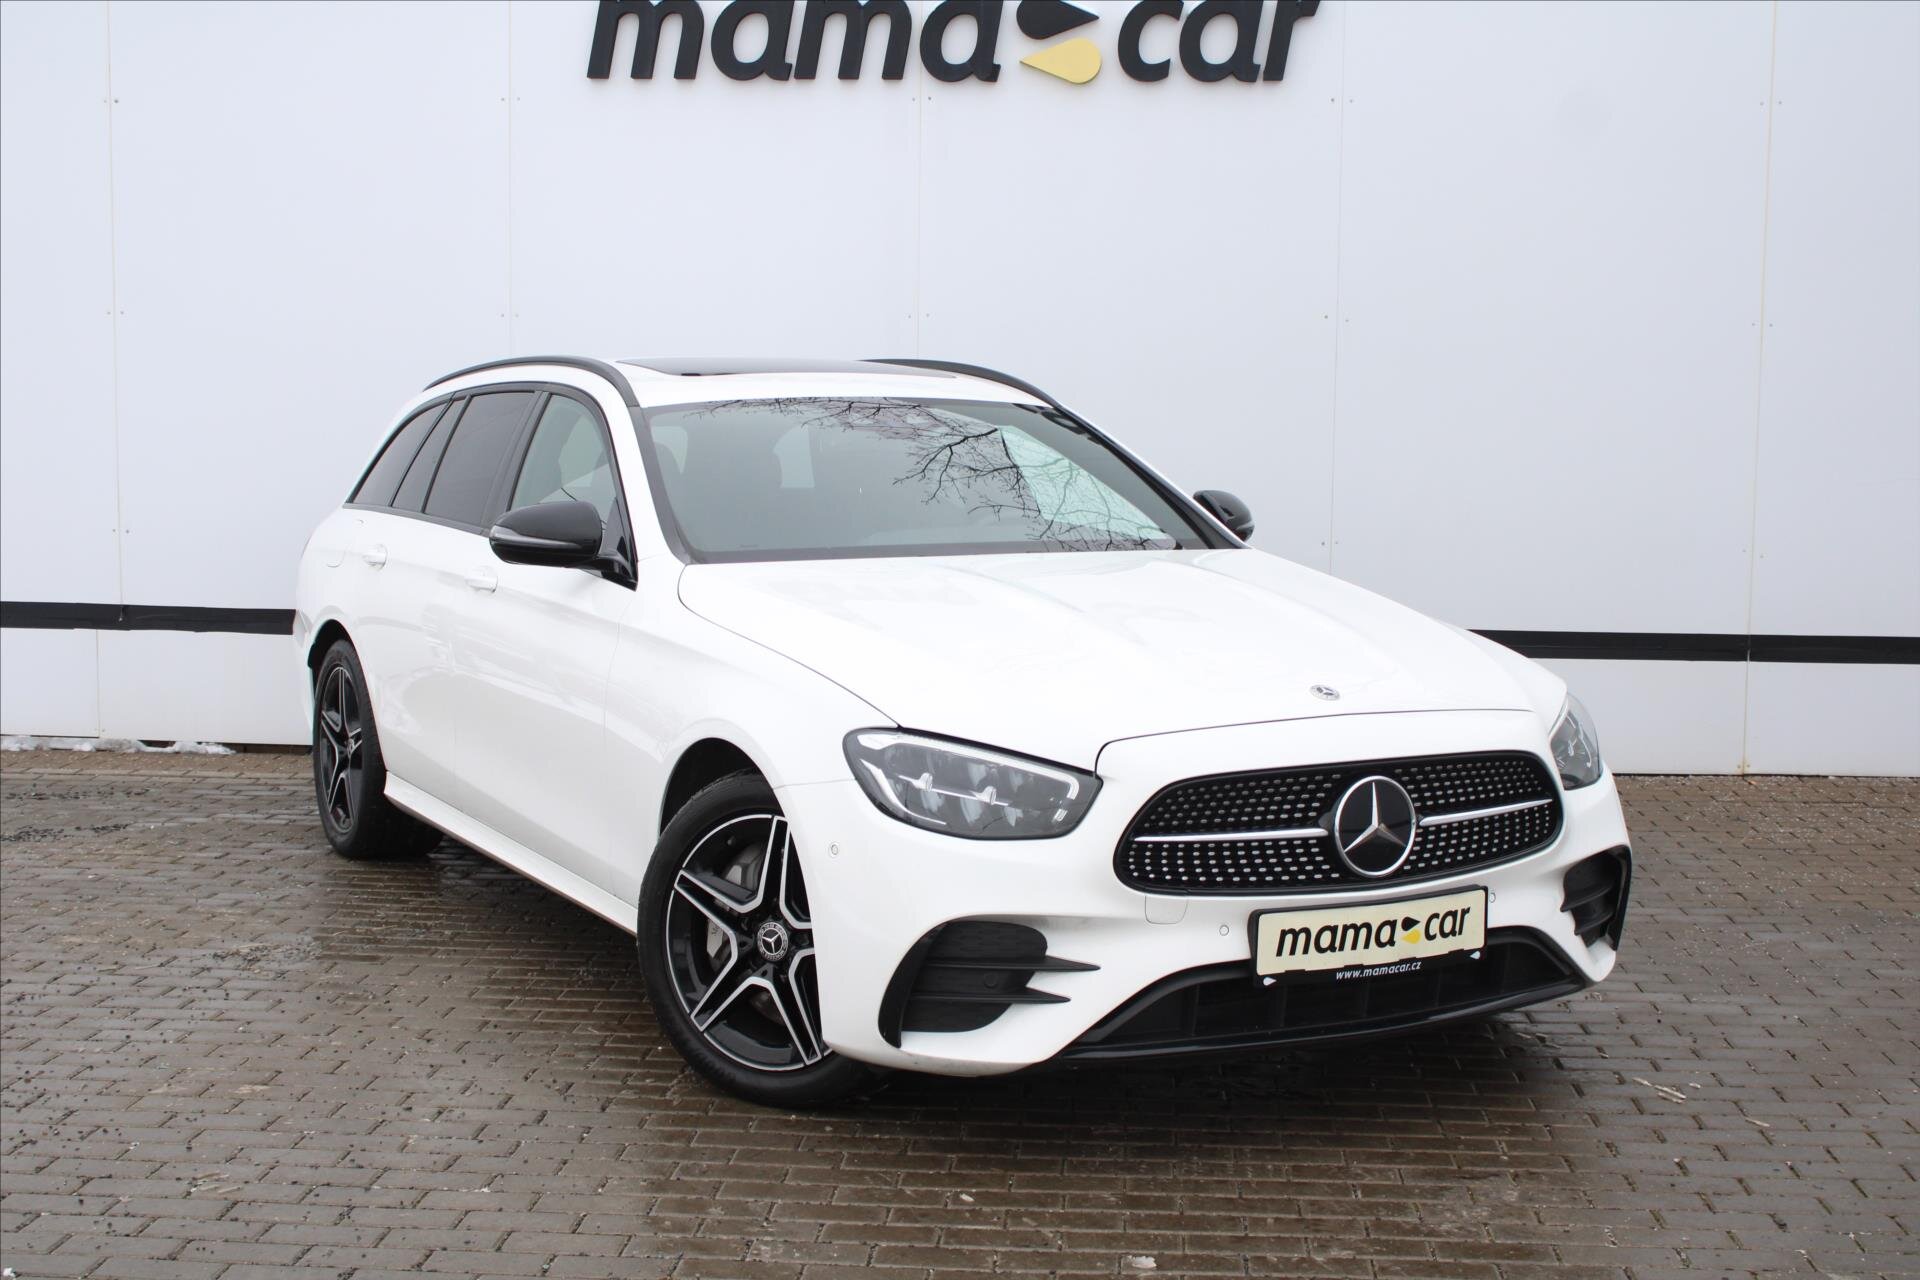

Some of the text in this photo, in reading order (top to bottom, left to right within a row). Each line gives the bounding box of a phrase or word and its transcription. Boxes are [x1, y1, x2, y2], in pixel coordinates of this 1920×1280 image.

[587, 0, 1320, 83] mama car
[1276, 907, 1471, 957] mama car
[1336, 961, 1422, 980] www.mamacar.cz
